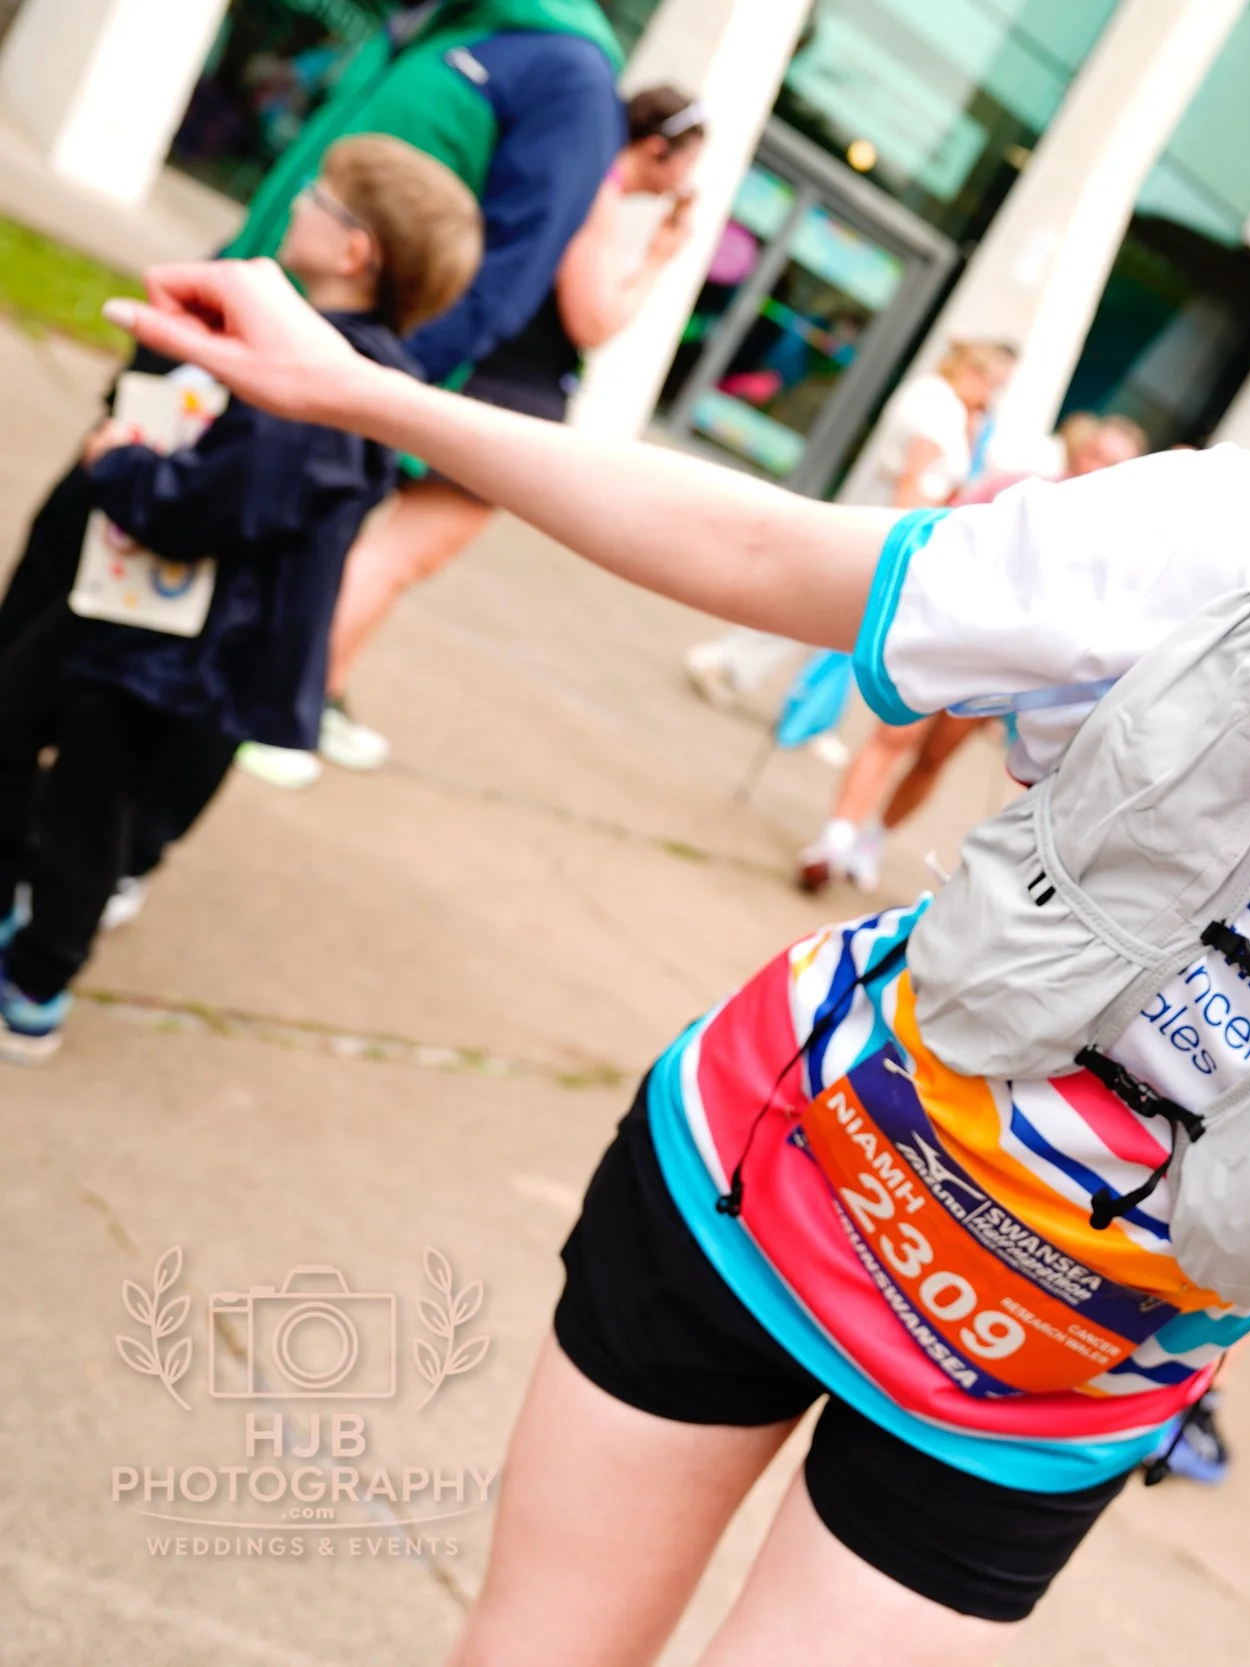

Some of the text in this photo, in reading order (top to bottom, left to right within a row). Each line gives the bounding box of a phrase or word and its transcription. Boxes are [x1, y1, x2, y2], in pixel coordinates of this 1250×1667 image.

[826, 1091, 925, 1214] NIAMH
[838, 1172, 1026, 1360] 2309
[984, 1207, 1103, 1290] SWANSEA
[1066, 1323, 1122, 1357] CANCER
